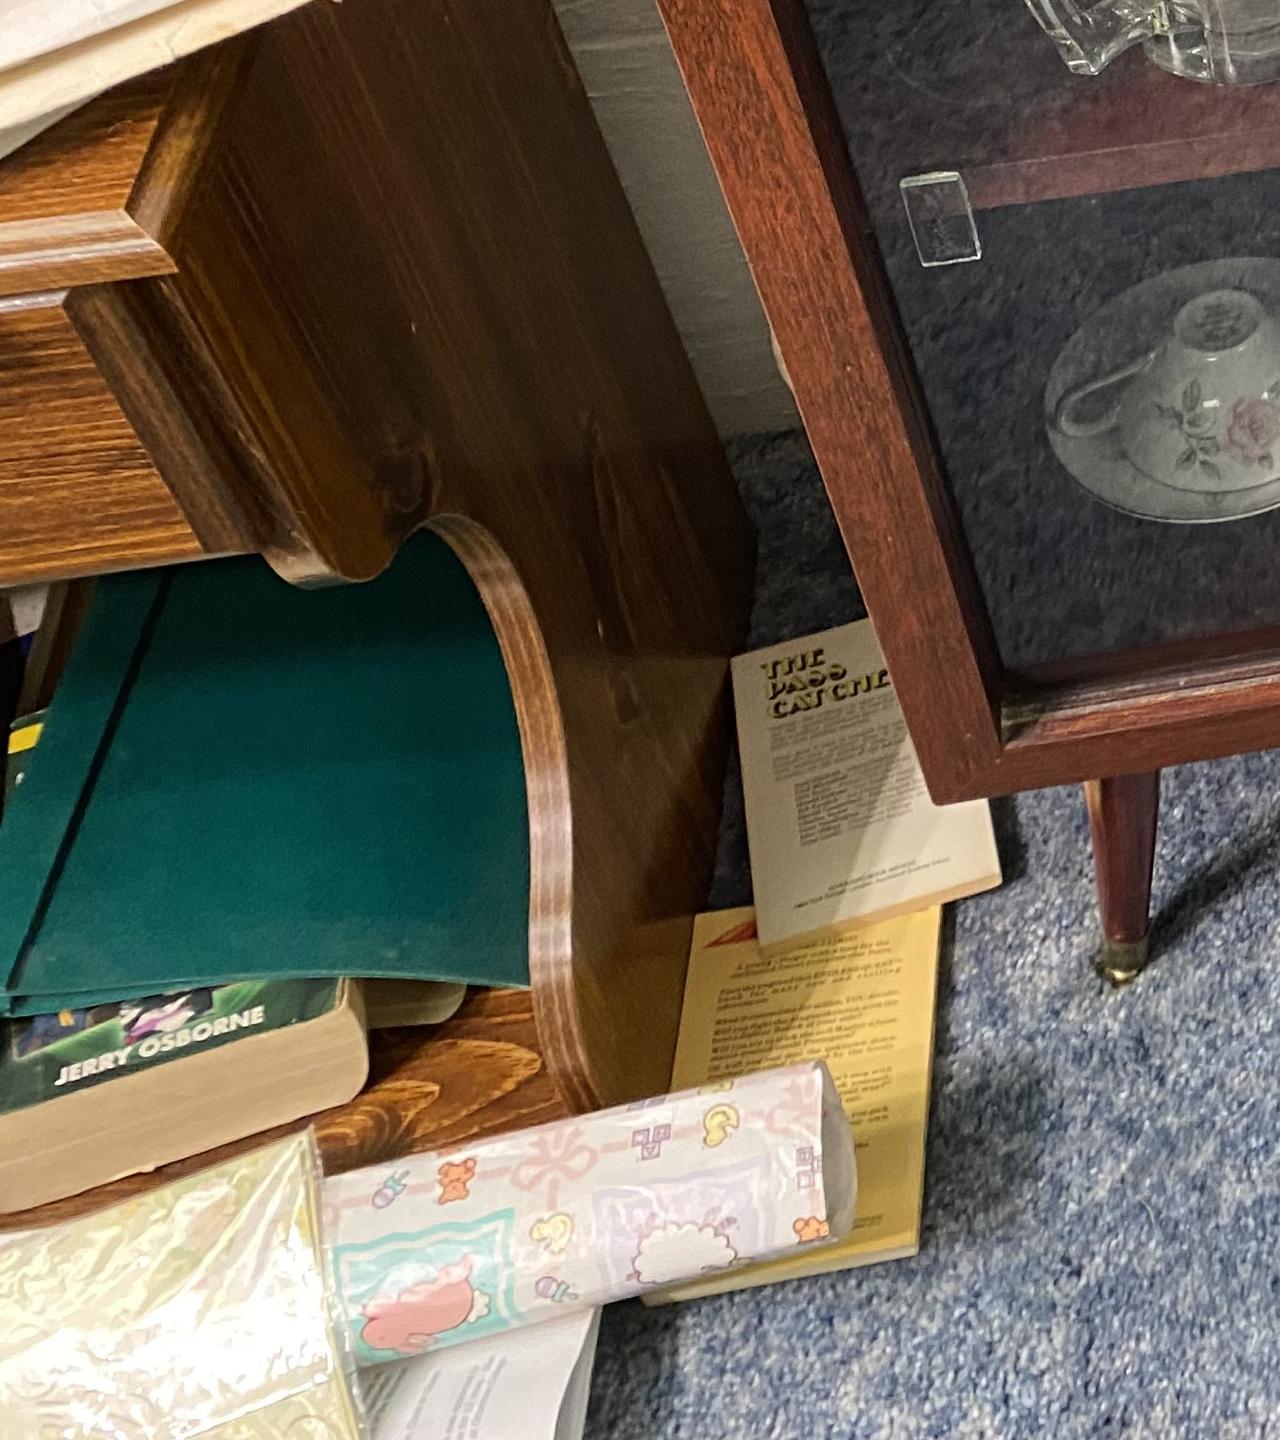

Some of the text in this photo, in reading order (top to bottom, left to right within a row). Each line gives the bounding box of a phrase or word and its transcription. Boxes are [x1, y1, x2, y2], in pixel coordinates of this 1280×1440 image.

[760, 648, 826, 680] THE
[54, 1004, 266, 1086] JERRY OSBORNE
